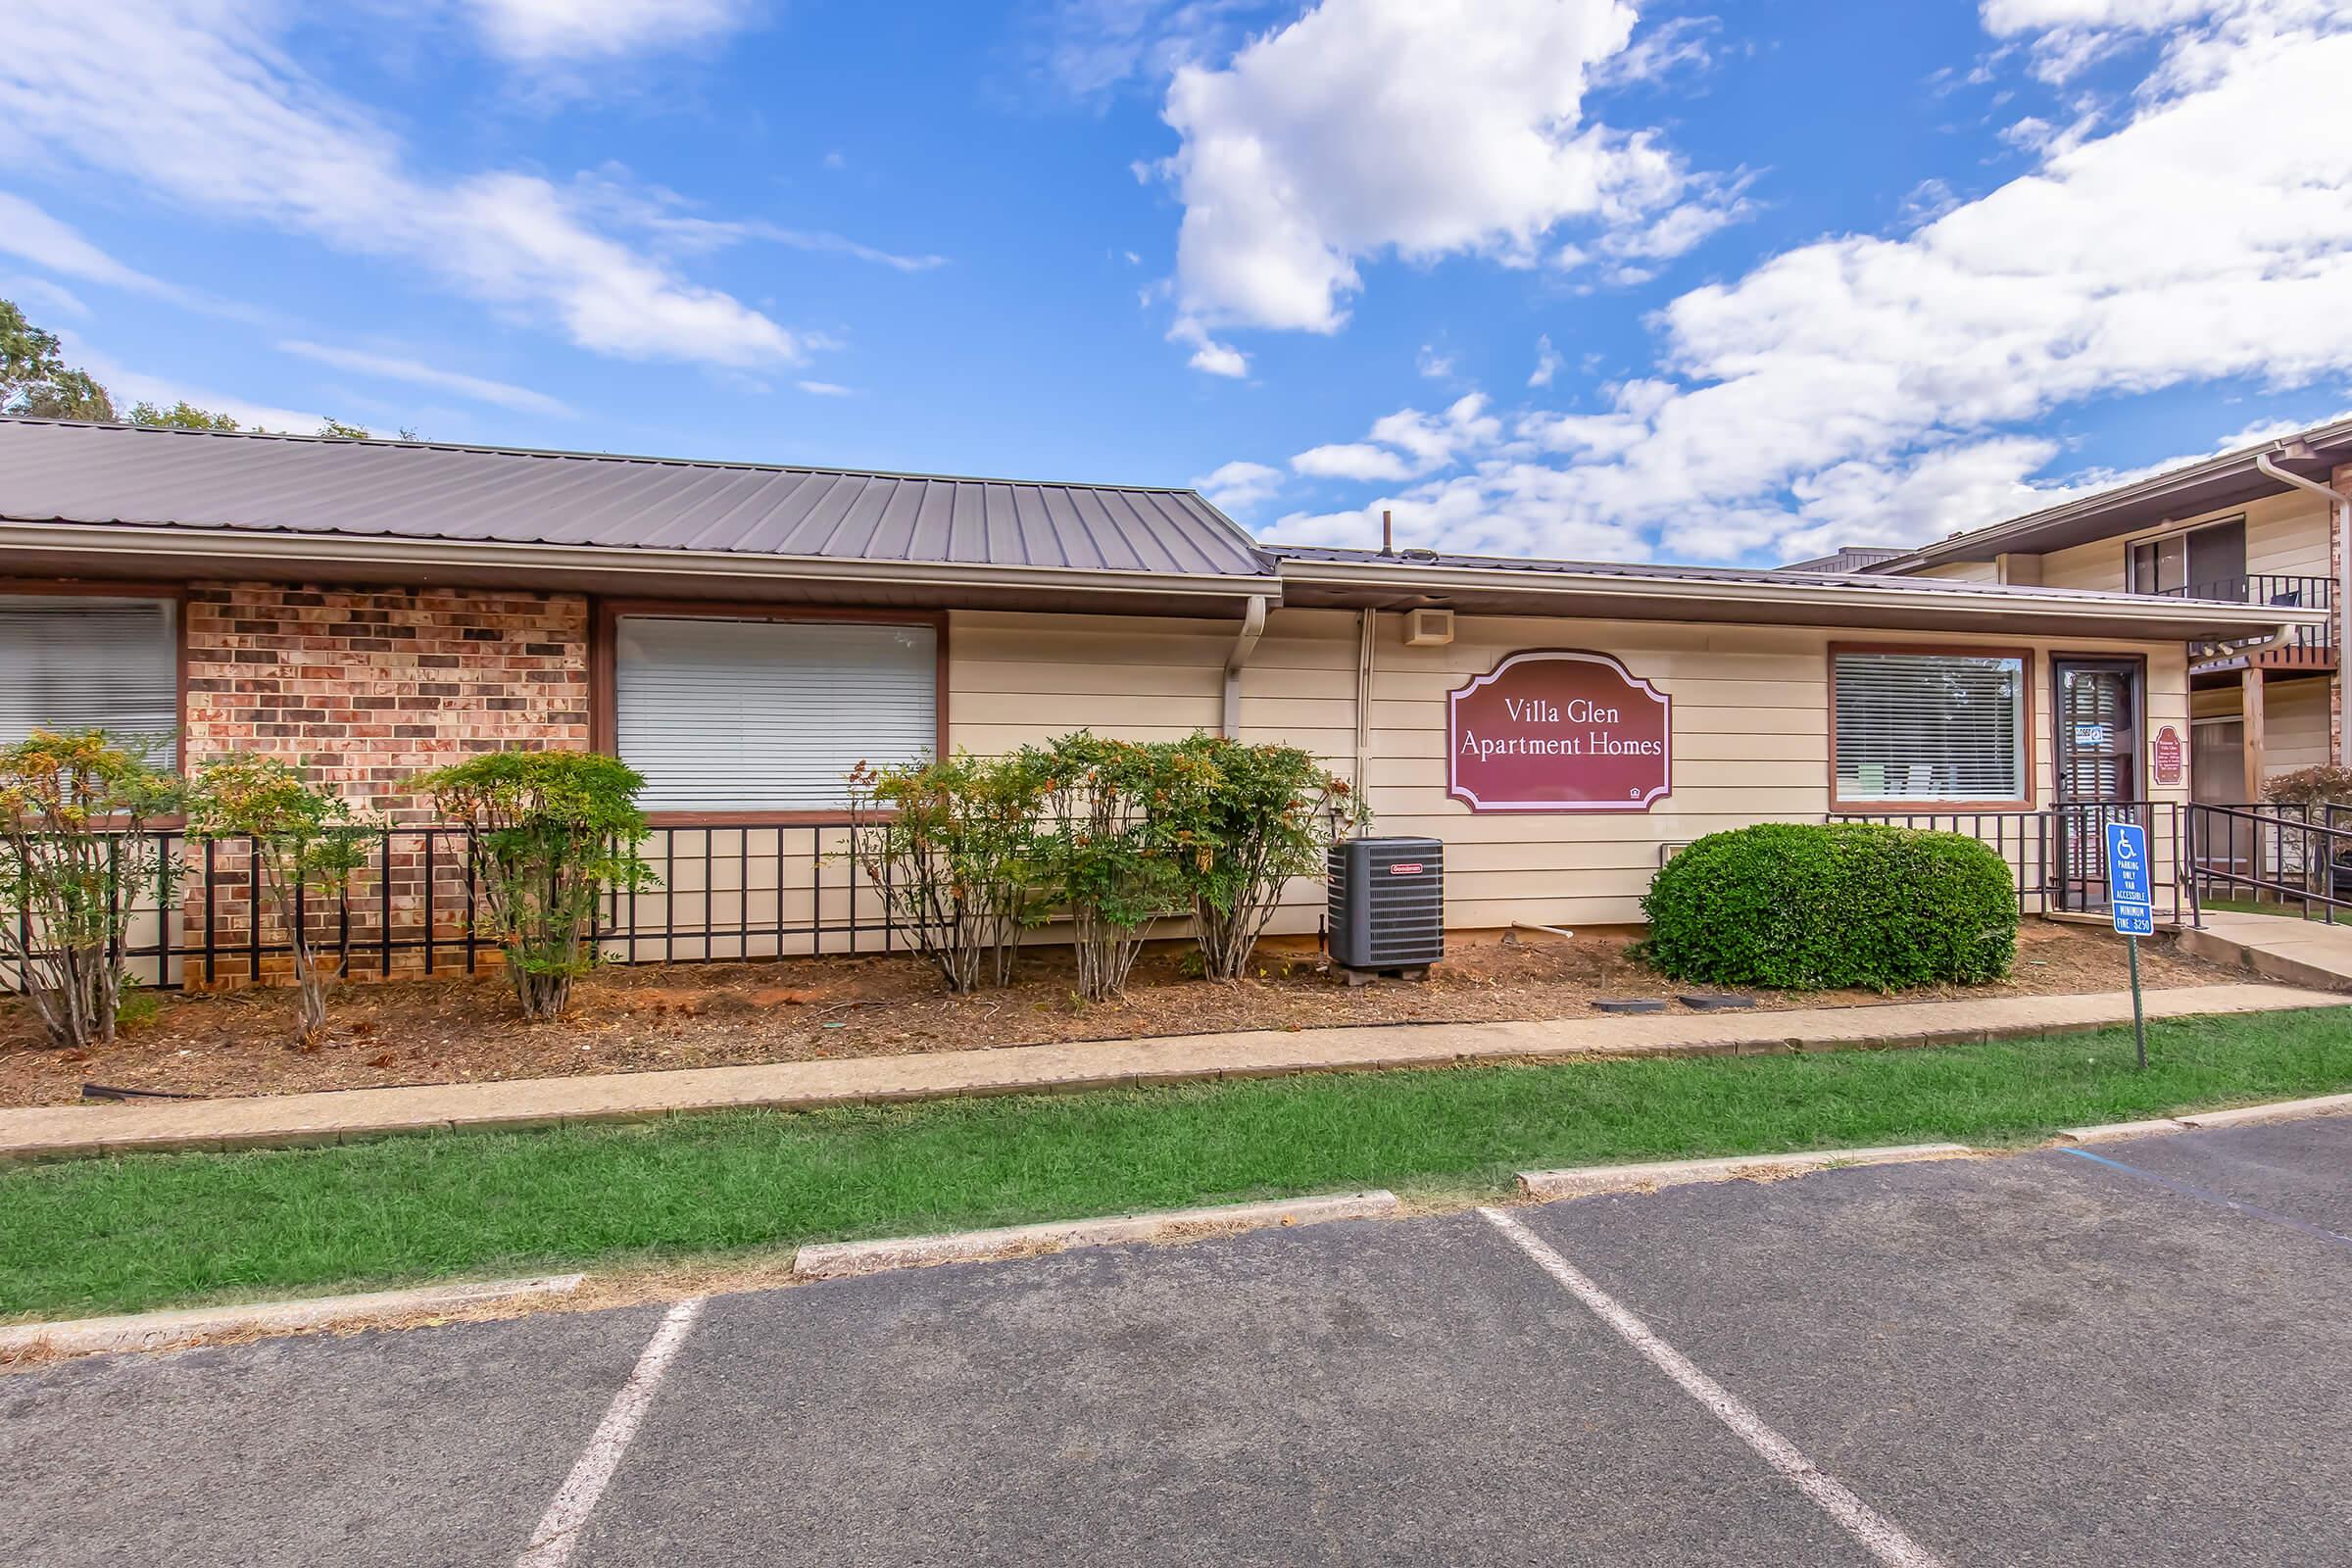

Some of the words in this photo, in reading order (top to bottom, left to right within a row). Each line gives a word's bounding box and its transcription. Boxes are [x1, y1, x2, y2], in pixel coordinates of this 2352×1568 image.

[1504, 698, 1560, 722] Villa
[1567, 699, 1620, 723] Glen
[1460, 730, 1582, 762] Apartment
[1589, 731, 1663, 757] Homes
[2118, 860, 2139, 871] PARKING
[2123, 870, 2135, 880] ONLY
[2125, 881, 2134, 890] VAN
[2117, 890, 2145, 902] ACCESSIBLE
[2120, 906, 2145, 917] MINIMUM
[2117, 917, 2130, 929] FINE
[2133, 917, 2150, 931] $250
